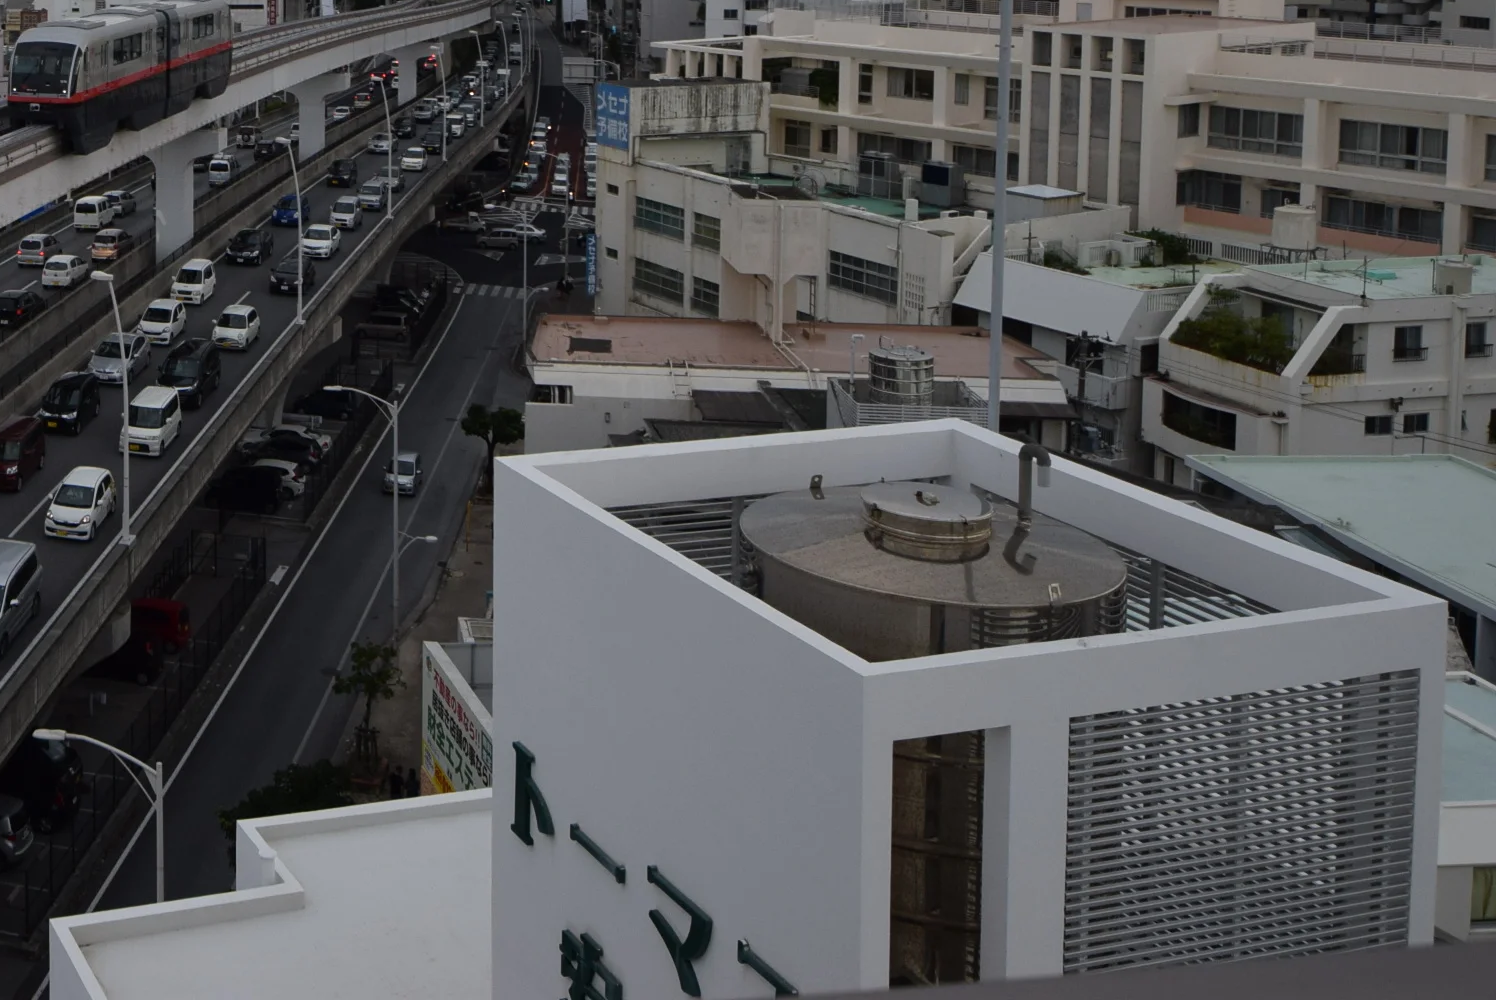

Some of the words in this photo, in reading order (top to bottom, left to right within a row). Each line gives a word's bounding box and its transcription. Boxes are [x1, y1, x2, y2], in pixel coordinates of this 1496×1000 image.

[597, 91, 629, 116] メセナ
[597, 116, 628, 142] 予備校
[427, 704, 477, 791] 財全エステ
